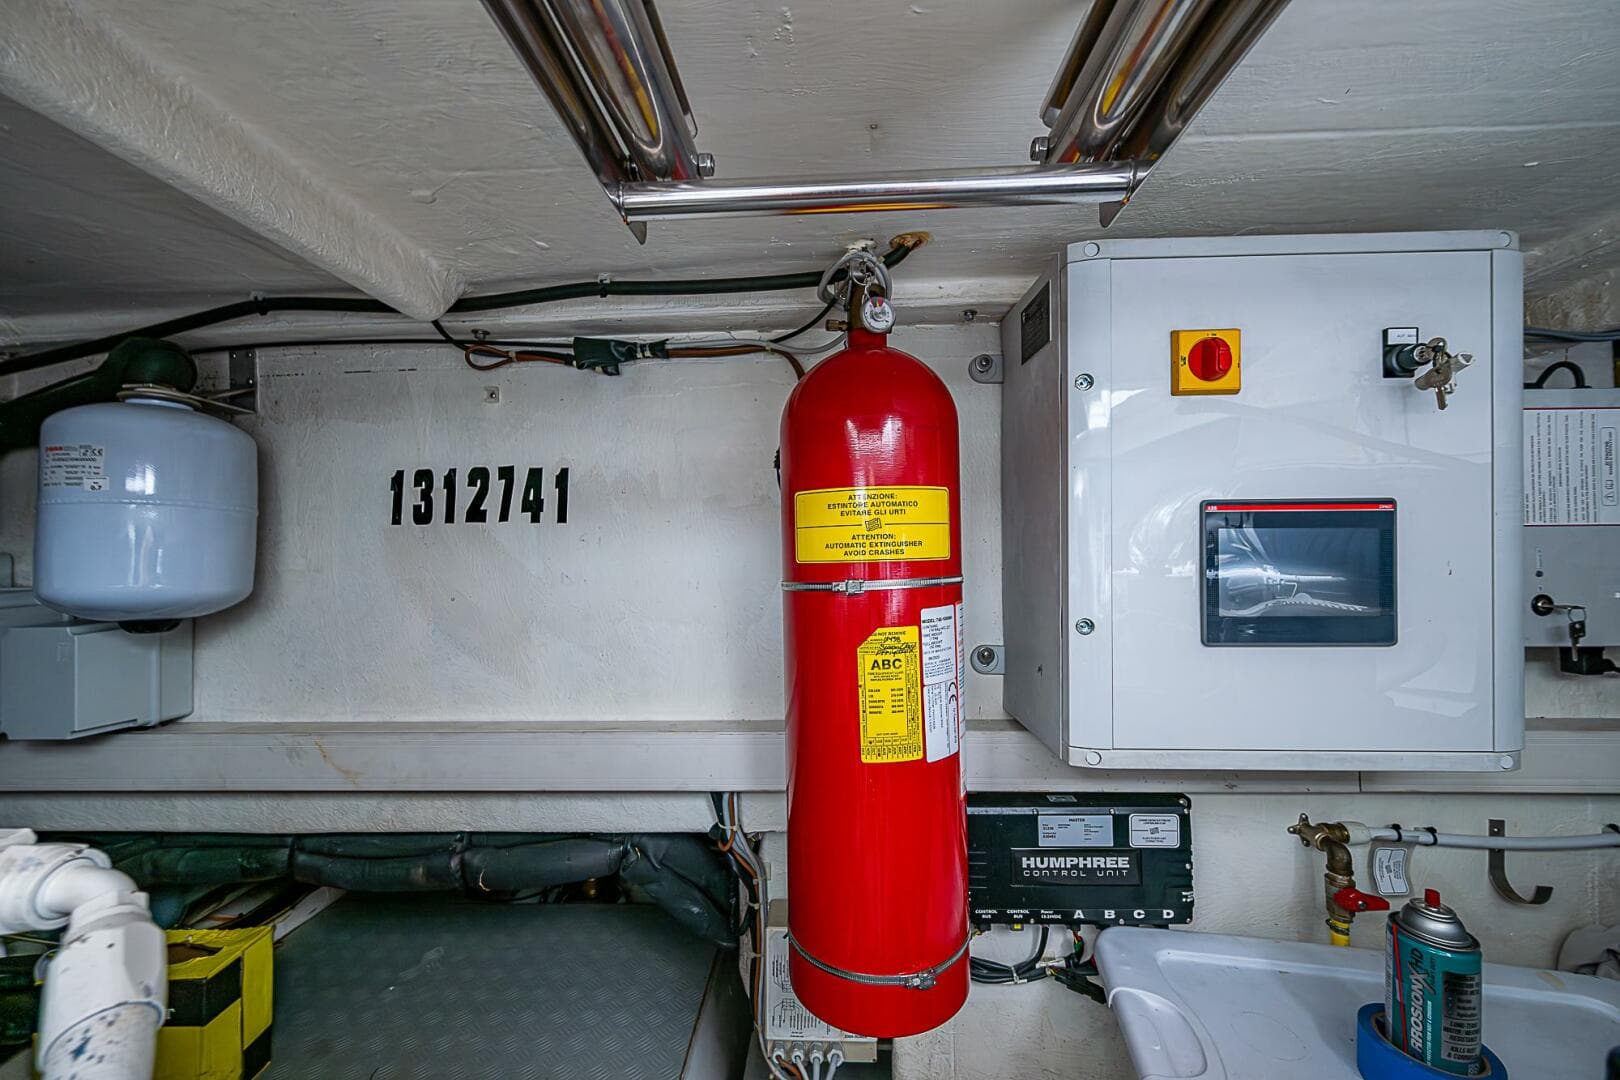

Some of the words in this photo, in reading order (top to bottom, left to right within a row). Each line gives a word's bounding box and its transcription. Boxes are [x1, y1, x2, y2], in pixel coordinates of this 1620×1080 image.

[390, 465, 569, 525] 1312741
[847, 493, 898, 501] ATTENZIONE:
[827, 501, 868, 510] ESTINTORE
[870, 500, 919, 508] AUTOMATICO
[840, 509, 872, 517] EVITARE
[824, 541, 867, 549] AUTOMATIC
[868, 540, 923, 548] EXTINGUISHER
[843, 549, 867, 557] AVOID
[868, 548, 905, 556] CRASHES
[871, 658, 902, 671] ABC
[1021, 856, 1130, 869] HUMPHREE
[1073, 909, 1085, 919] A
[1104, 909, 1116, 919] B
[1133, 909, 1146, 919] C
[1162, 909, 1175, 919] D
[1410, 960, 1433, 1053] RROSIONX
